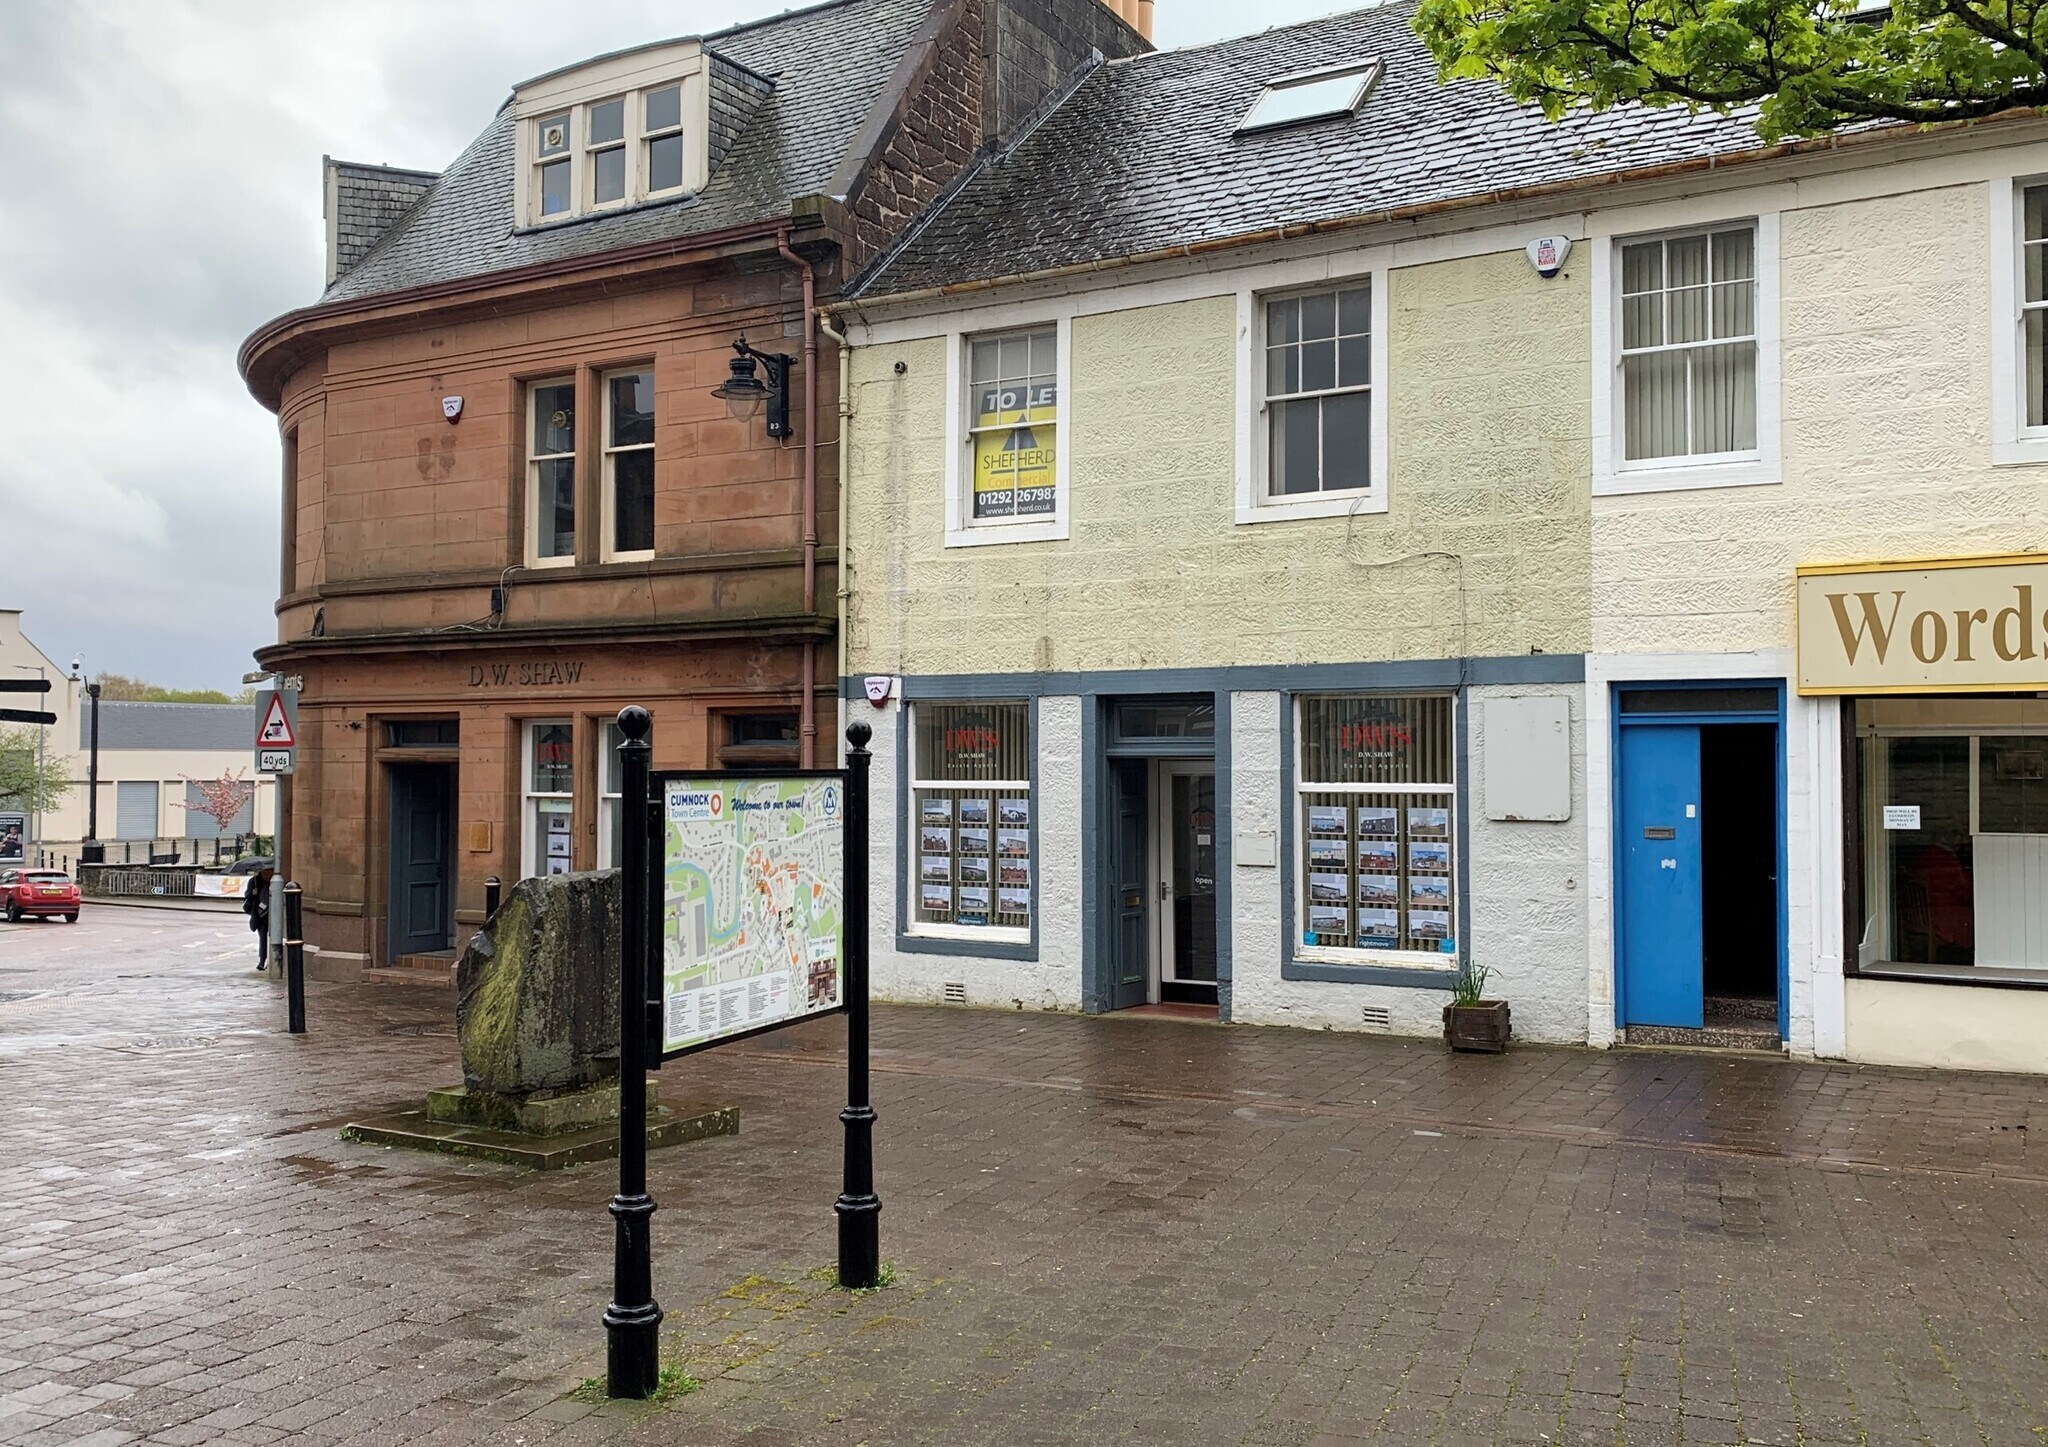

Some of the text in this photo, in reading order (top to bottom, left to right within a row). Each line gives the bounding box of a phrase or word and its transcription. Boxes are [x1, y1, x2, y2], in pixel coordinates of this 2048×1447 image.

[987, 387, 1057, 410] TO LE
[983, 449, 1057, 470] SHEPHERD
[979, 491, 1012, 506] 01292
[986, 503, 1051, 515] www.sheherd.co.uk
[1825, 585, 2048, 667] Word
[519, 661, 585, 685] SHAW
[263, 756, 287, 767] 40 yds
[671, 794, 709, 806] CUMNOCK
[731, 797, 762, 811] Welcome
[763, 800, 771, 809] to
[772, 801, 784, 809] our
[671, 807, 709, 818] Town Centre
[1195, 877, 1213, 885] open
